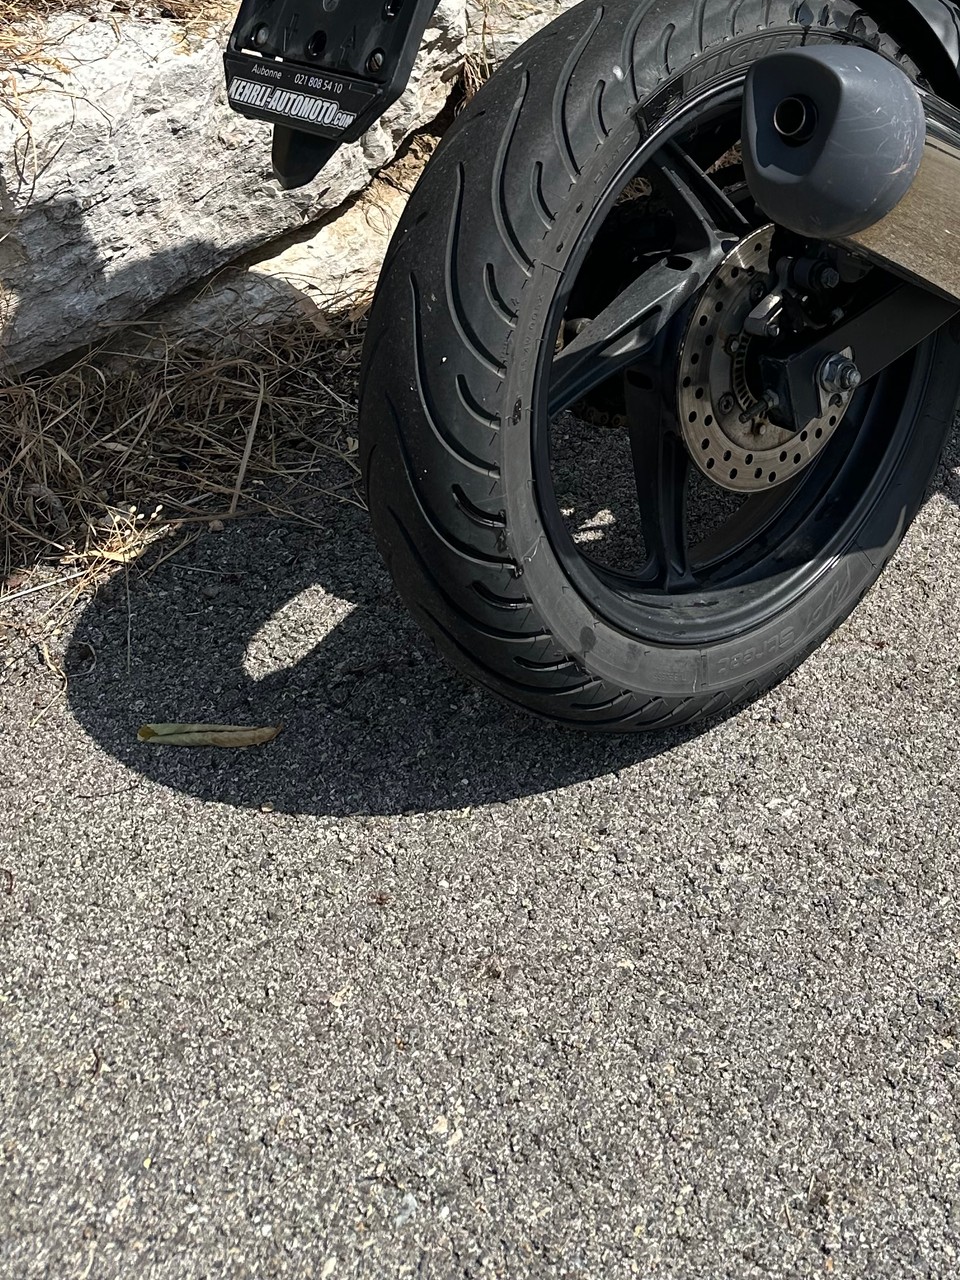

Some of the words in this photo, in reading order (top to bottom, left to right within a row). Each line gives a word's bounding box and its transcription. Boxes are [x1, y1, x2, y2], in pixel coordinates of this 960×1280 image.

[251, 64, 282, 80] Aubonne
[294, 73, 308, 86] 021
[308, 77, 322, 89] 808
[322, 81, 333, 91] 54
[333, 82, 343, 94] 10
